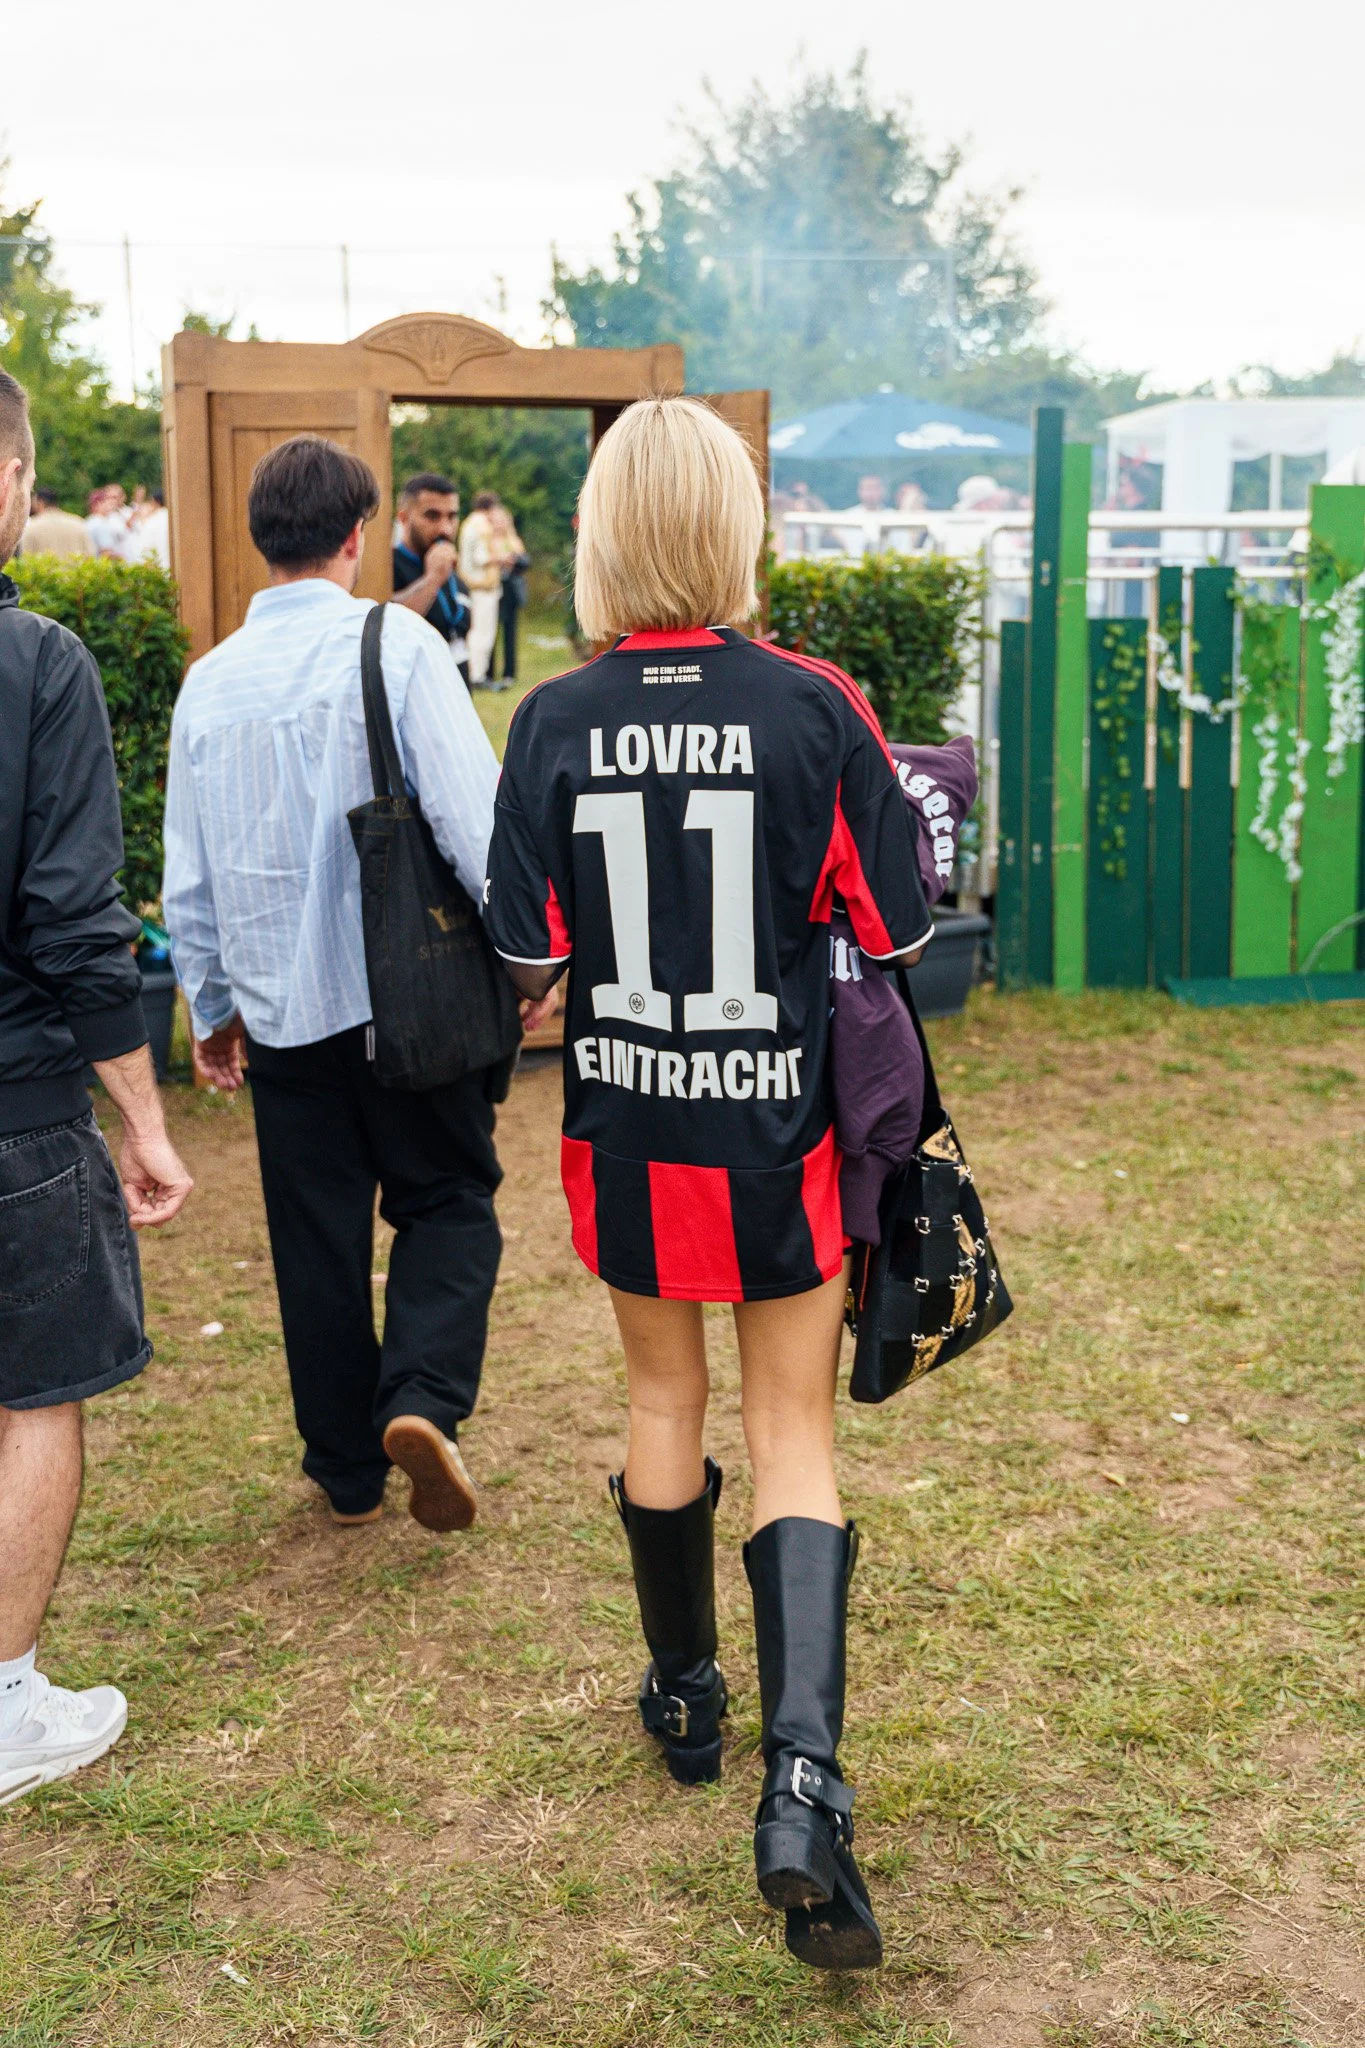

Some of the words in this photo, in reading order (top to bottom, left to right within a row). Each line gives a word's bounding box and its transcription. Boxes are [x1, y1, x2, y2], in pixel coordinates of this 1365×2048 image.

[643, 667, 659, 675] NUR
[660, 666, 677, 674] EINE
[677, 665, 702, 674] STADT.
[643, 676, 659, 684] NUR
[660, 675, 672, 683] EIN
[673, 674, 702, 683] VEREIN.
[590, 724, 754, 776] LOVRA
[572, 789, 778, 1033] 11
[574, 1037, 802, 1100] EINTRACHT
